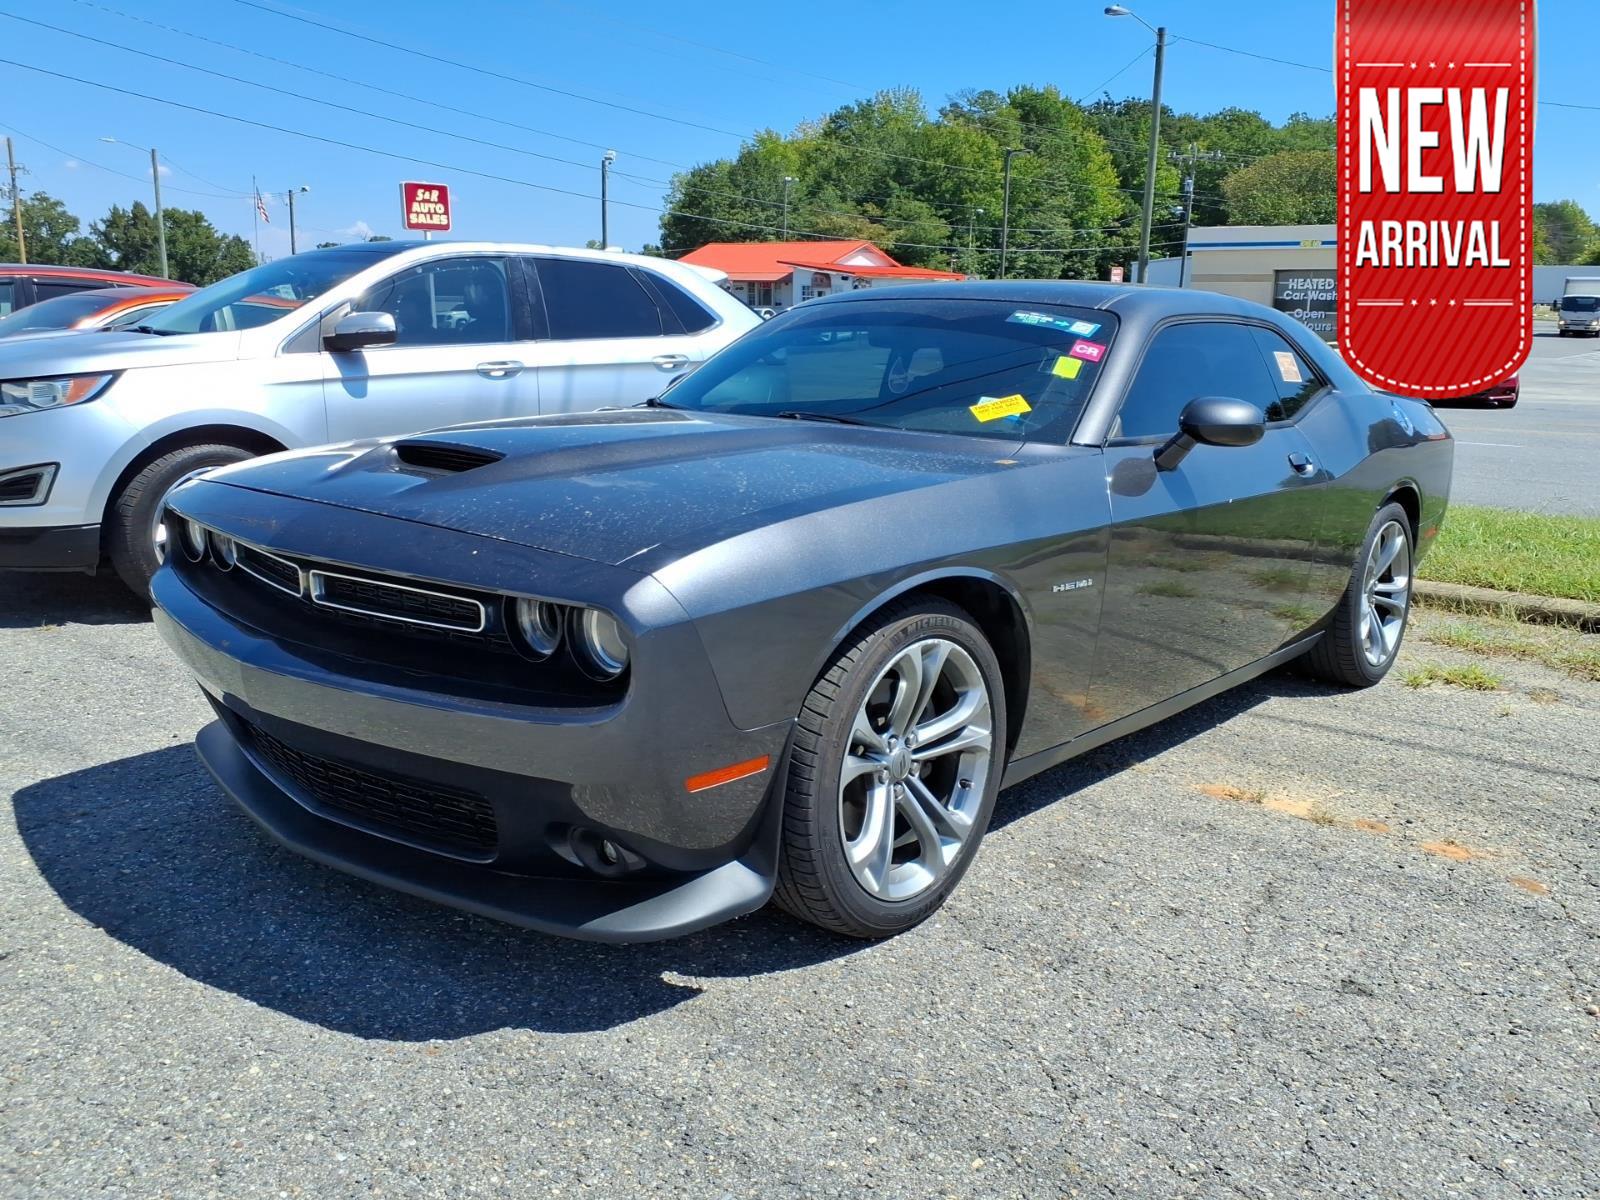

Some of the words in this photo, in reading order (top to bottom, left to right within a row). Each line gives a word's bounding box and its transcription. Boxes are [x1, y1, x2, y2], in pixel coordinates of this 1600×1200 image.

[412, 201, 445, 214] AUTO
[409, 213, 448, 225] SALES
[1288, 278, 1335, 290] HEATED
[1283, 290, 1305, 300] Car
[1308, 290, 1338, 301] Wash
[1294, 308, 1326, 320] Open
[1075, 344, 1100, 357] CR
[1053, 578, 1093, 593] HEMI
